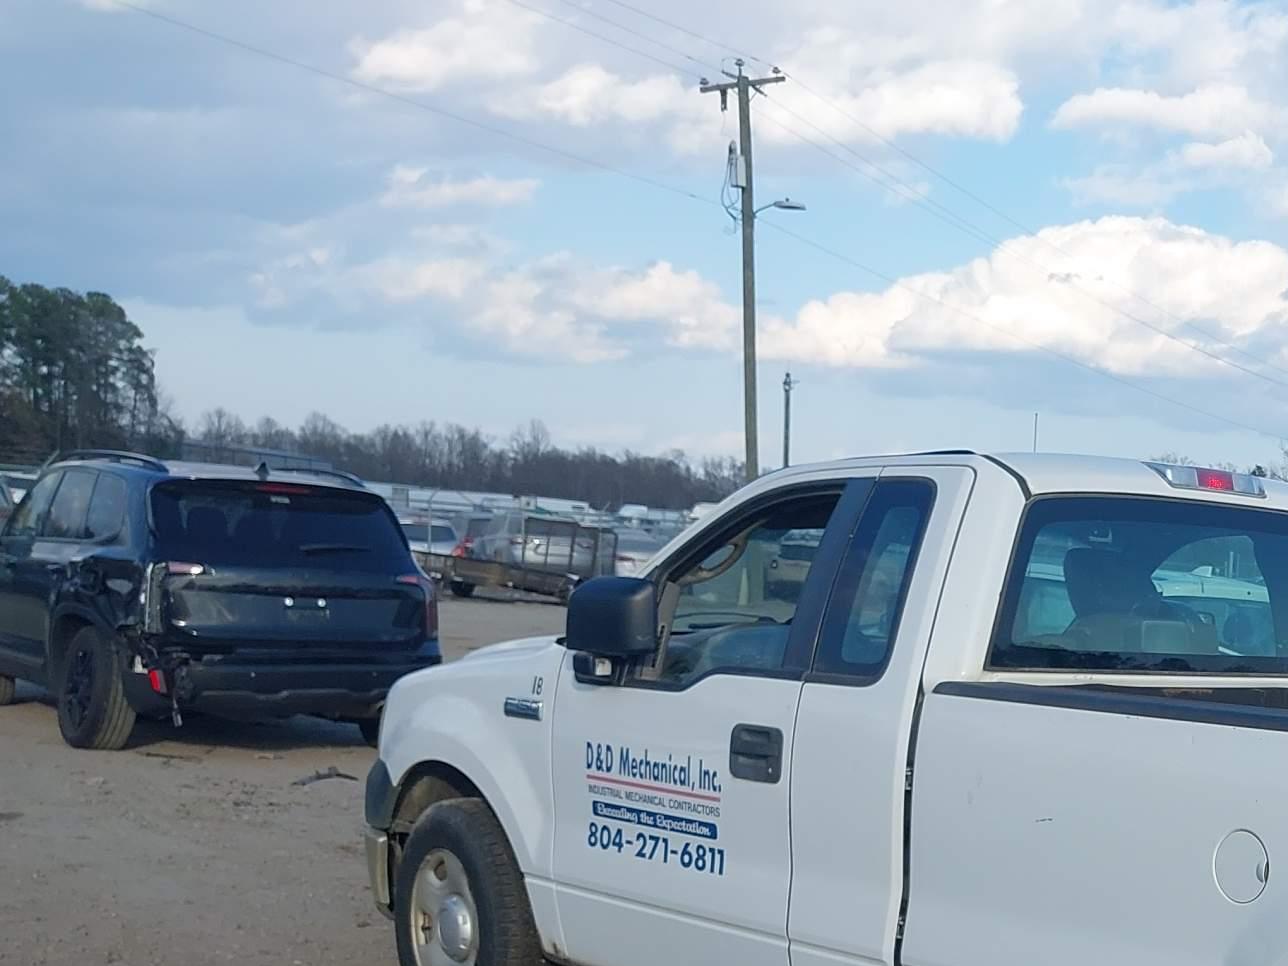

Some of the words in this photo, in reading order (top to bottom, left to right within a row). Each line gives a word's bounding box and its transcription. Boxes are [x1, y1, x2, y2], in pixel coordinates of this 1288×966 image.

[586, 741, 614, 773] D&D
[619, 746, 696, 792] Mechanical,
[699, 758, 722, 793] Inc.
[588, 784, 624, 800] INDUSTRIAL
[624, 790, 666, 808] MECHANICAL
[668, 798, 721, 818] CONTRACTORS
[640, 811, 654, 824] the
[587, 821, 725, 876] 804-271-6811
